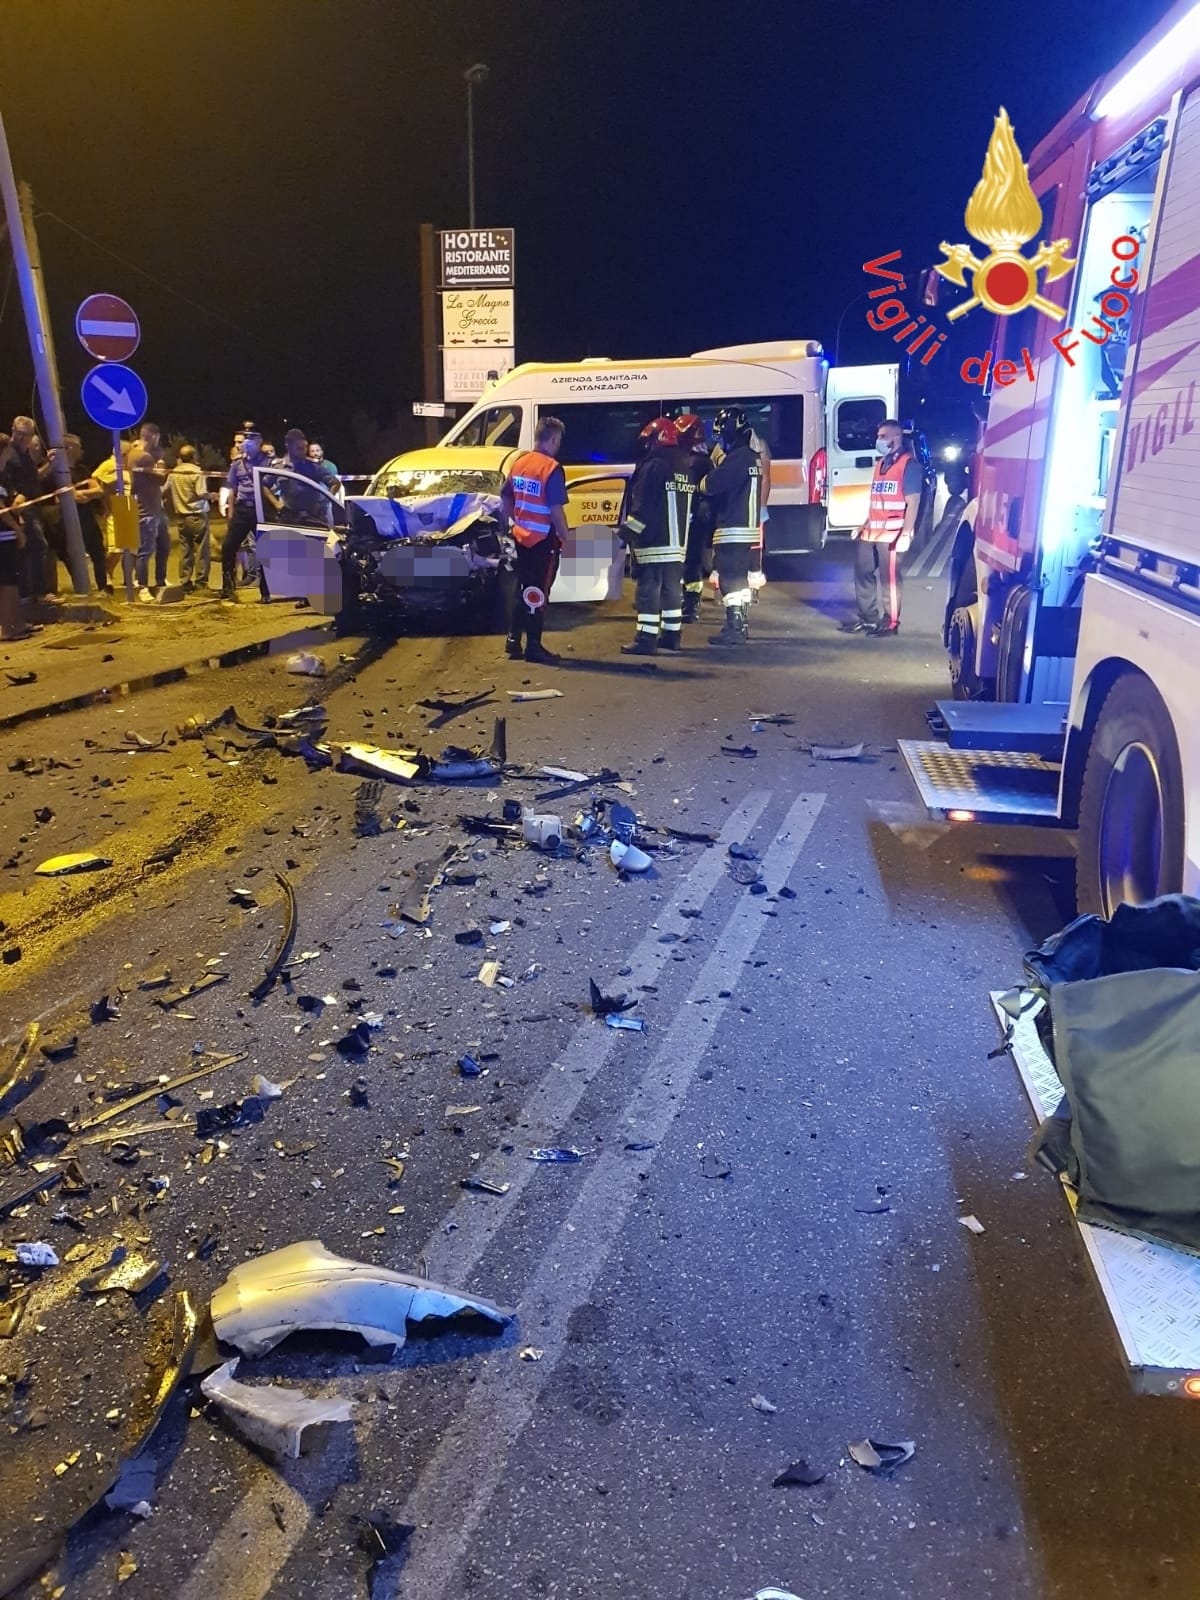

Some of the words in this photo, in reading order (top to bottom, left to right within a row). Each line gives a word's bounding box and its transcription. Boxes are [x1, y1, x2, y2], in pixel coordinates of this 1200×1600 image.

[445, 232, 496, 249] HOTEL
[445, 250, 510, 263] RISTORANTE
[446, 264, 510, 276] MEDITERRANEO
[446, 294, 463, 309] La
[467, 294, 511, 314] Magna
[459, 309, 498, 329] Grecia
[595, 374, 648, 382] SANITARIA
[569, 383, 629, 391] CATANZARO
[581, 501, 598, 510] SEU
